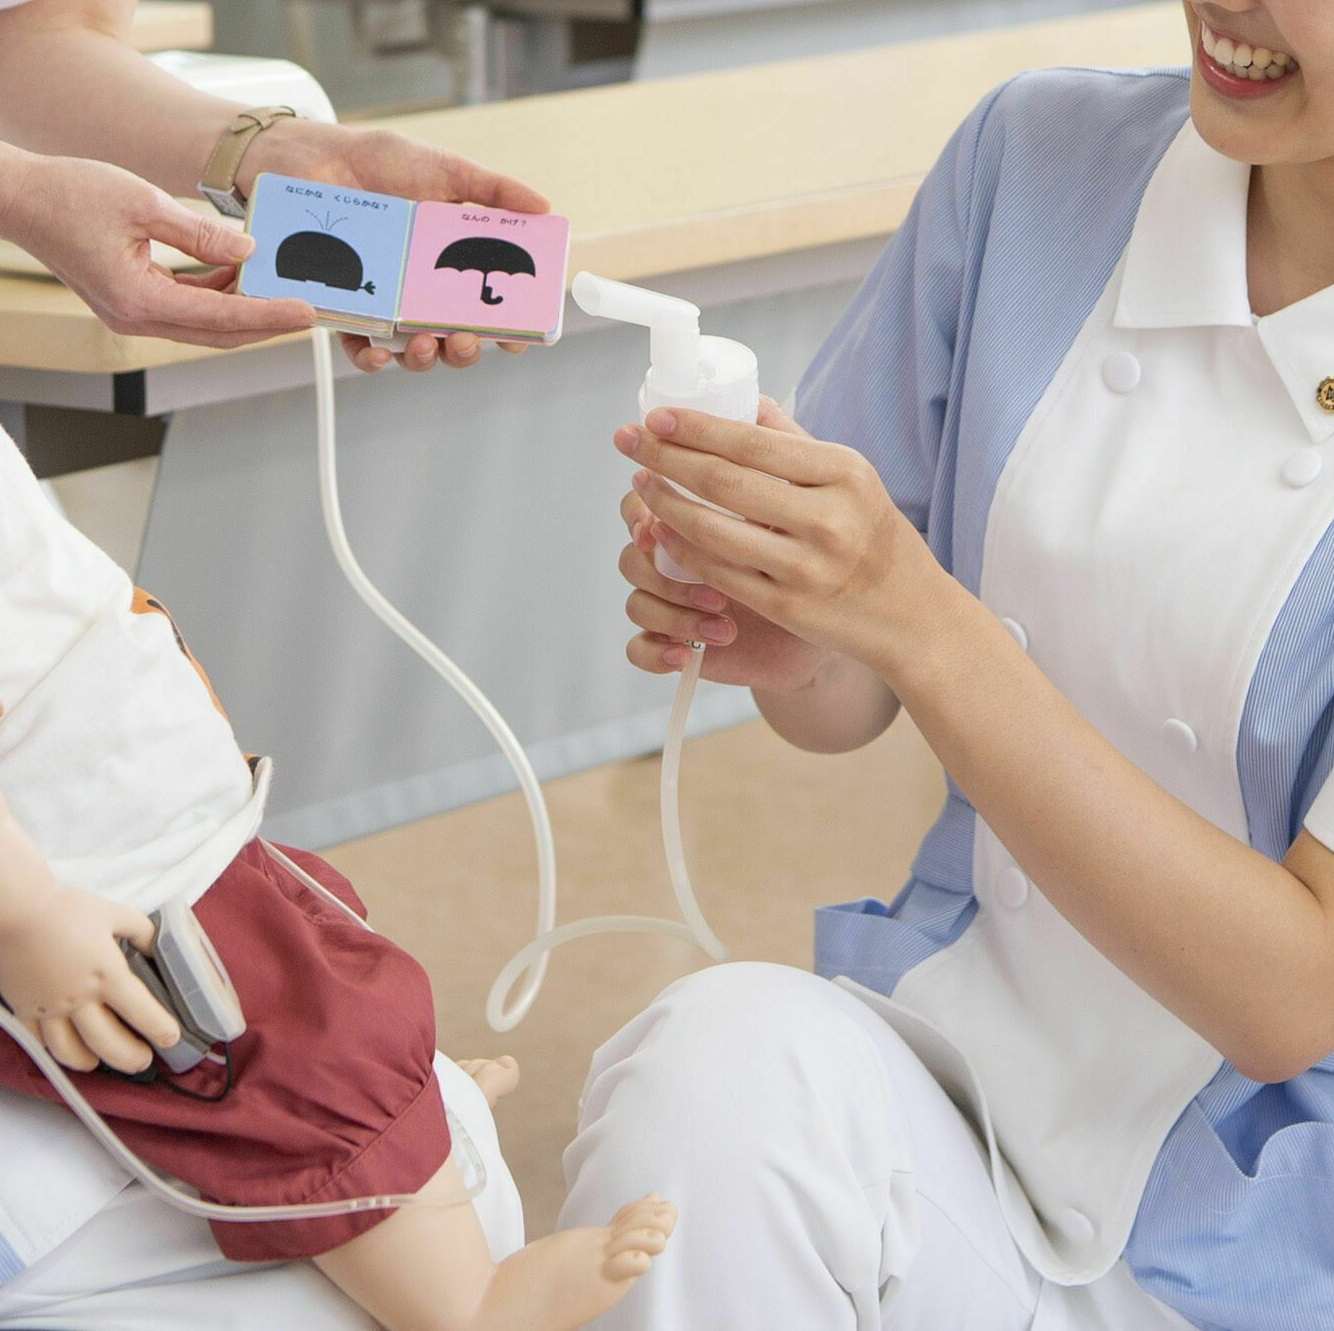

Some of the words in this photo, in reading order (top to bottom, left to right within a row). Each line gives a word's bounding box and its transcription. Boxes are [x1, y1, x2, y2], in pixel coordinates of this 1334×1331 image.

[285, 185, 323, 198] なにかな
[461, 213, 490, 223] なんの
